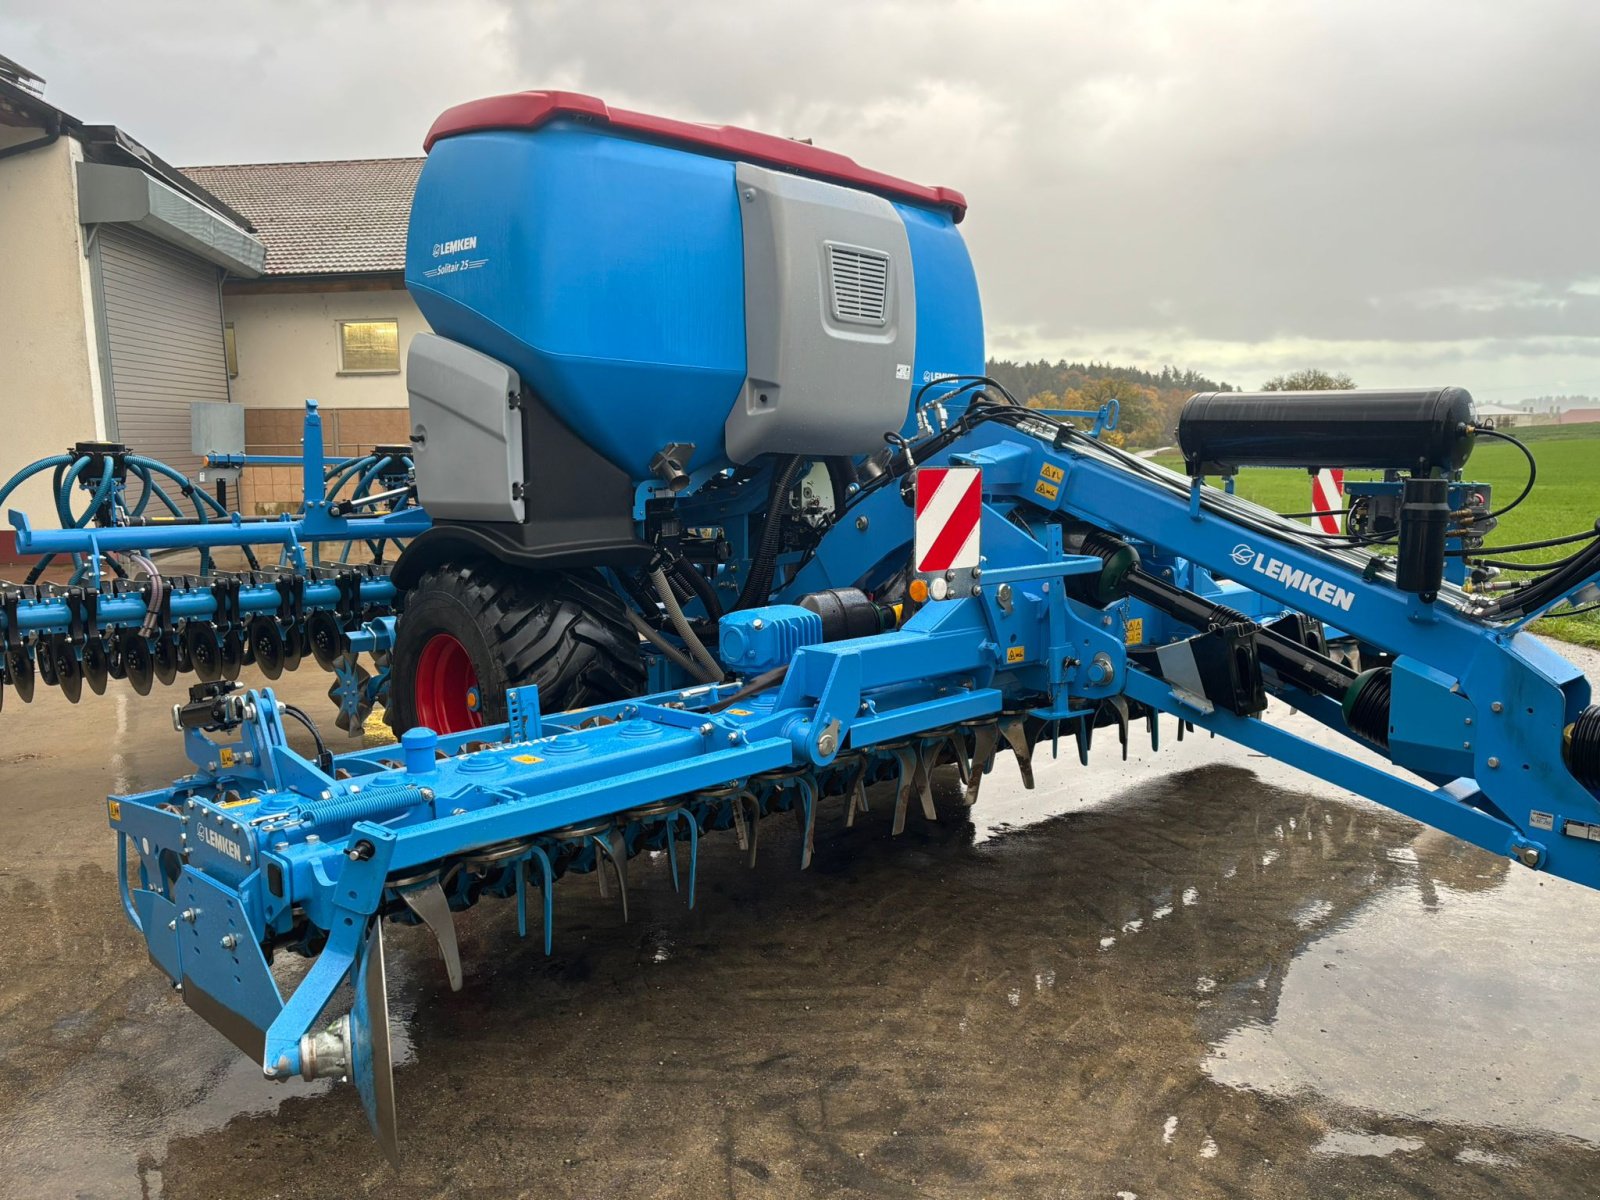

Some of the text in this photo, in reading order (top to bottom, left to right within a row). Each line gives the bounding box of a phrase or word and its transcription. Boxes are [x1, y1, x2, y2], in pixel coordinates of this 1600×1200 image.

[440, 236, 477, 256] LEMKEN
[437, 259, 470, 276] Solitair 25
[1252, 552, 1356, 612] LEMKEN
[204, 826, 242, 863] LEMKEN
